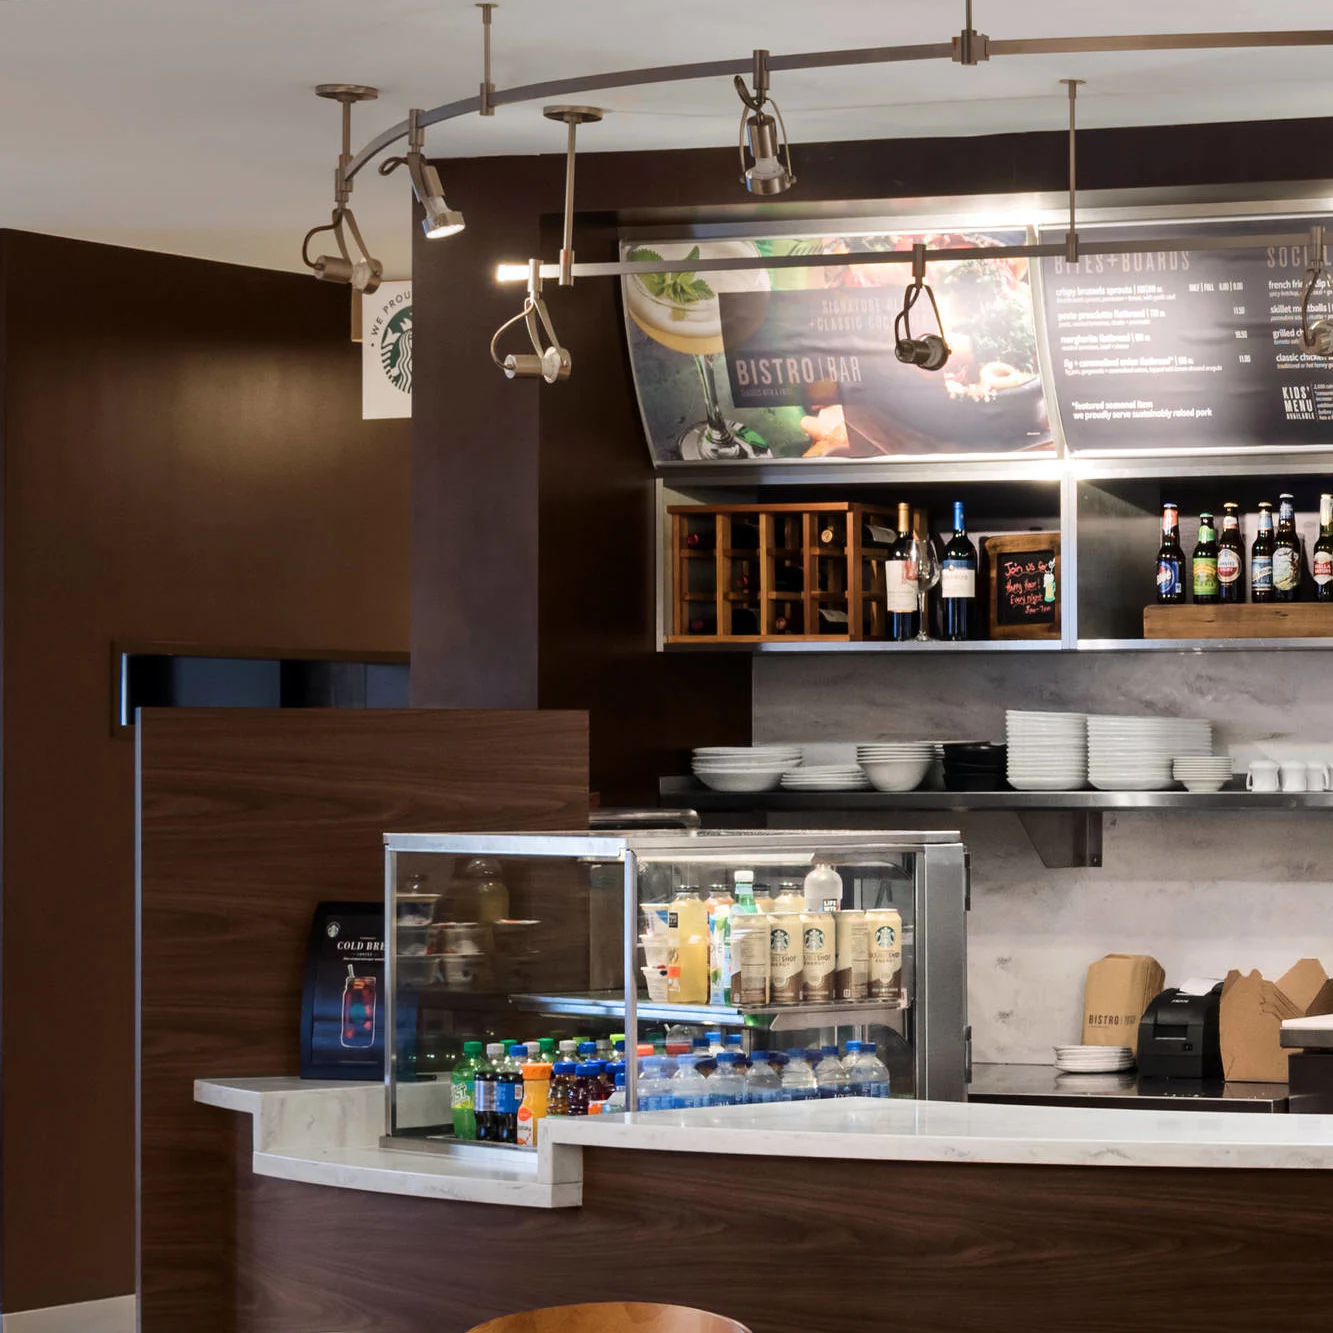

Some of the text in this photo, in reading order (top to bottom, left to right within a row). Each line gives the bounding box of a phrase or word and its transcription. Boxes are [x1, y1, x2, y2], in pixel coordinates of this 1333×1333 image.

[1267, 244, 1332, 269] SOCIL
[1268, 280, 1291, 290] french
[371, 290, 411, 336] WE PROU
[1270, 304, 1291, 314] skillet
[1273, 326, 1294, 339] grilled
[1276, 353, 1299, 362] classic
[735, 355, 862, 386] BISTRO BAR
[1282, 386, 1310, 400] KIDS'
[1284, 399, 1313, 413] MENU
[1073, 411, 1085, 420] we
[1085, 409, 1112, 421] proudly
[1112, 410, 1131, 419] serve
[1173, 407, 1195, 418] raised
[1195, 407, 1213, 419] pork
[1004, 562, 1023, 578] Join
[1026, 562, 1035, 571] us
[337, 941, 385, 951] COLD BRE
[1088, 1014, 1119, 1025] BISTRO
